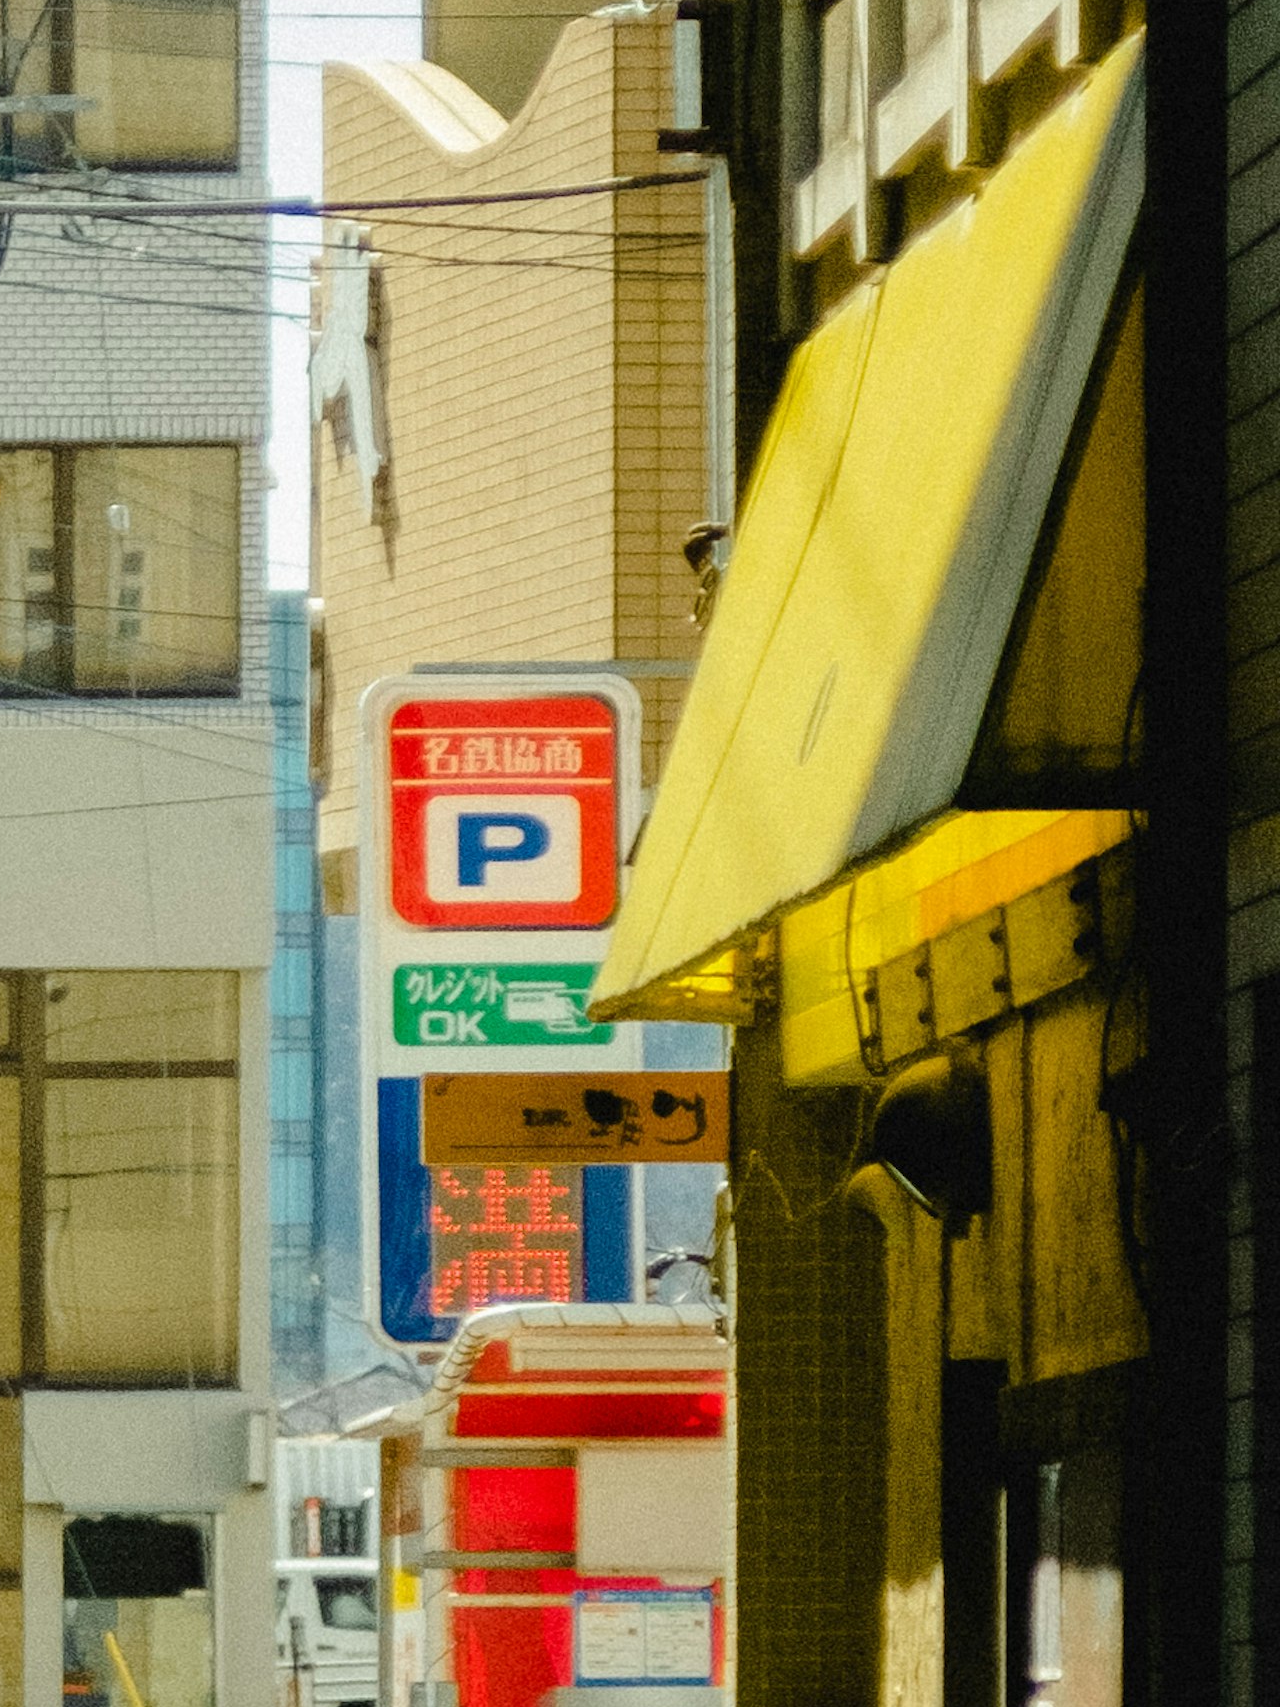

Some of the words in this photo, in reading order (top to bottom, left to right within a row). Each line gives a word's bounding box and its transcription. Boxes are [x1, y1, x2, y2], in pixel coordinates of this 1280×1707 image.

[423, 736, 583, 775] 名鉄協商
[457, 812, 550, 887] P
[405, 969, 506, 1007] クレジット
[418, 1010, 488, 1043] OK
